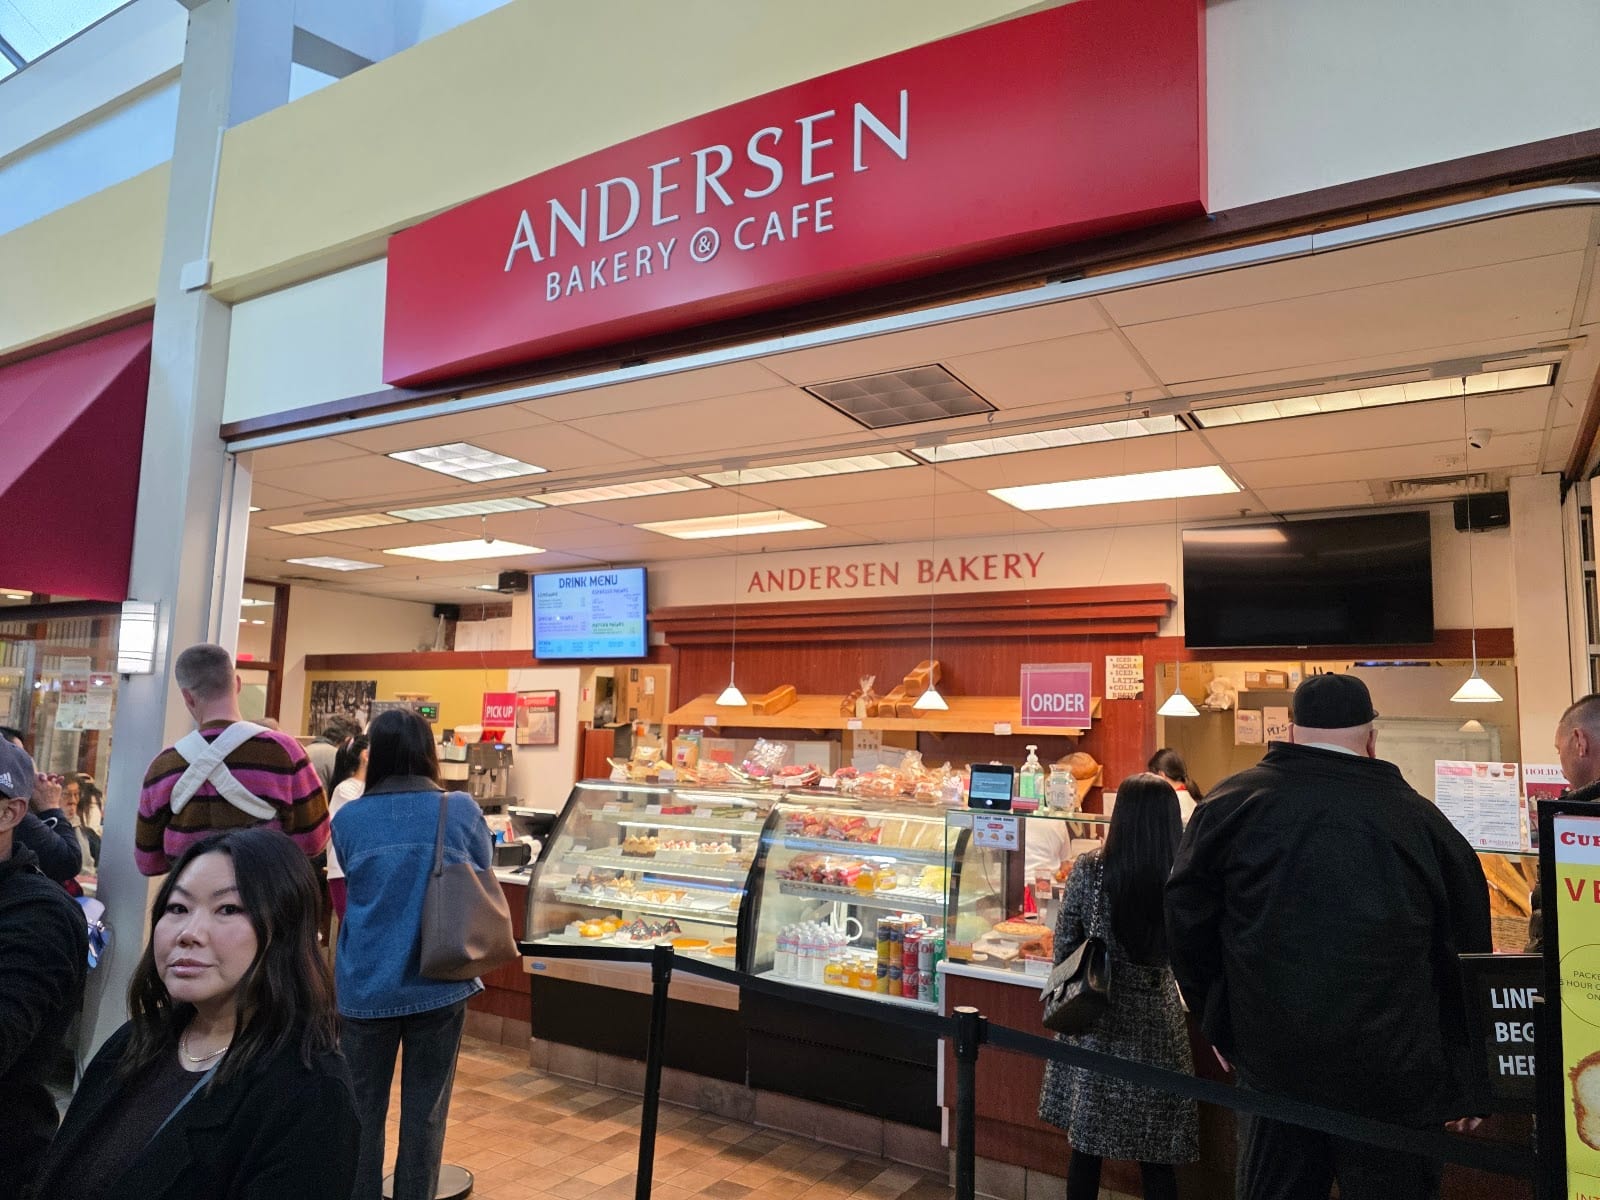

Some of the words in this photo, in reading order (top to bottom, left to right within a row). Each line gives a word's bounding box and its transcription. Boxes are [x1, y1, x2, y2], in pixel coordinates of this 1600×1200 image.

[503, 89, 908, 273] ANDERSEN
[545, 237, 678, 302] BAKERY
[733, 196, 835, 251] CAFE
[747, 561, 899, 593] ANDERSEN
[917, 551, 1046, 584] BAKERY
[559, 576, 587, 589] DRINK
[589, 574, 618, 586] MENU
[1031, 693, 1085, 712] ORDER
[486, 705, 502, 718] PICK
[503, 705, 514, 717] UP
[1525, 768, 1561, 776] HOLID
[1566, 979, 1593, 990] HOUR
